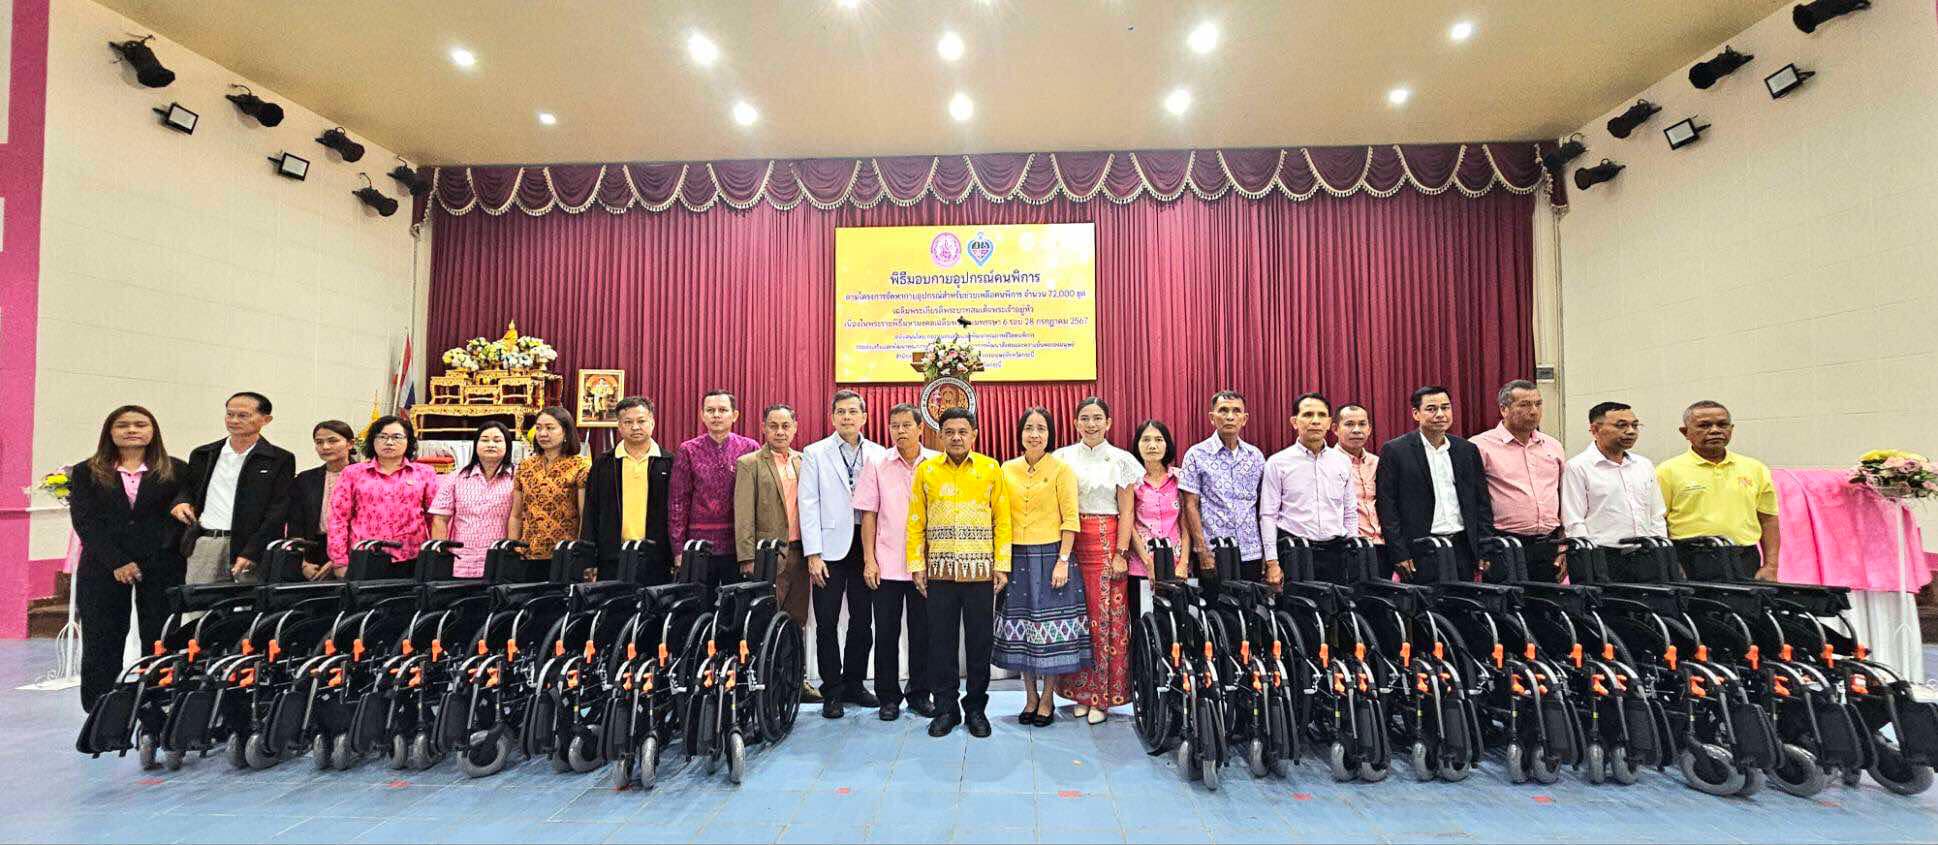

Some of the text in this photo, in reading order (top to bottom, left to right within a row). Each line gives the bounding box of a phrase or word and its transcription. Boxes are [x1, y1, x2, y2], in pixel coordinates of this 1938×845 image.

[890, 270, 1040, 288] พิธีมอบกายอุปกรณ์คนพิการ
[1048, 289, 1075, 298] 72,000
[1024, 317, 1034, 326] 28
[1070, 316, 1089, 325] 2567
